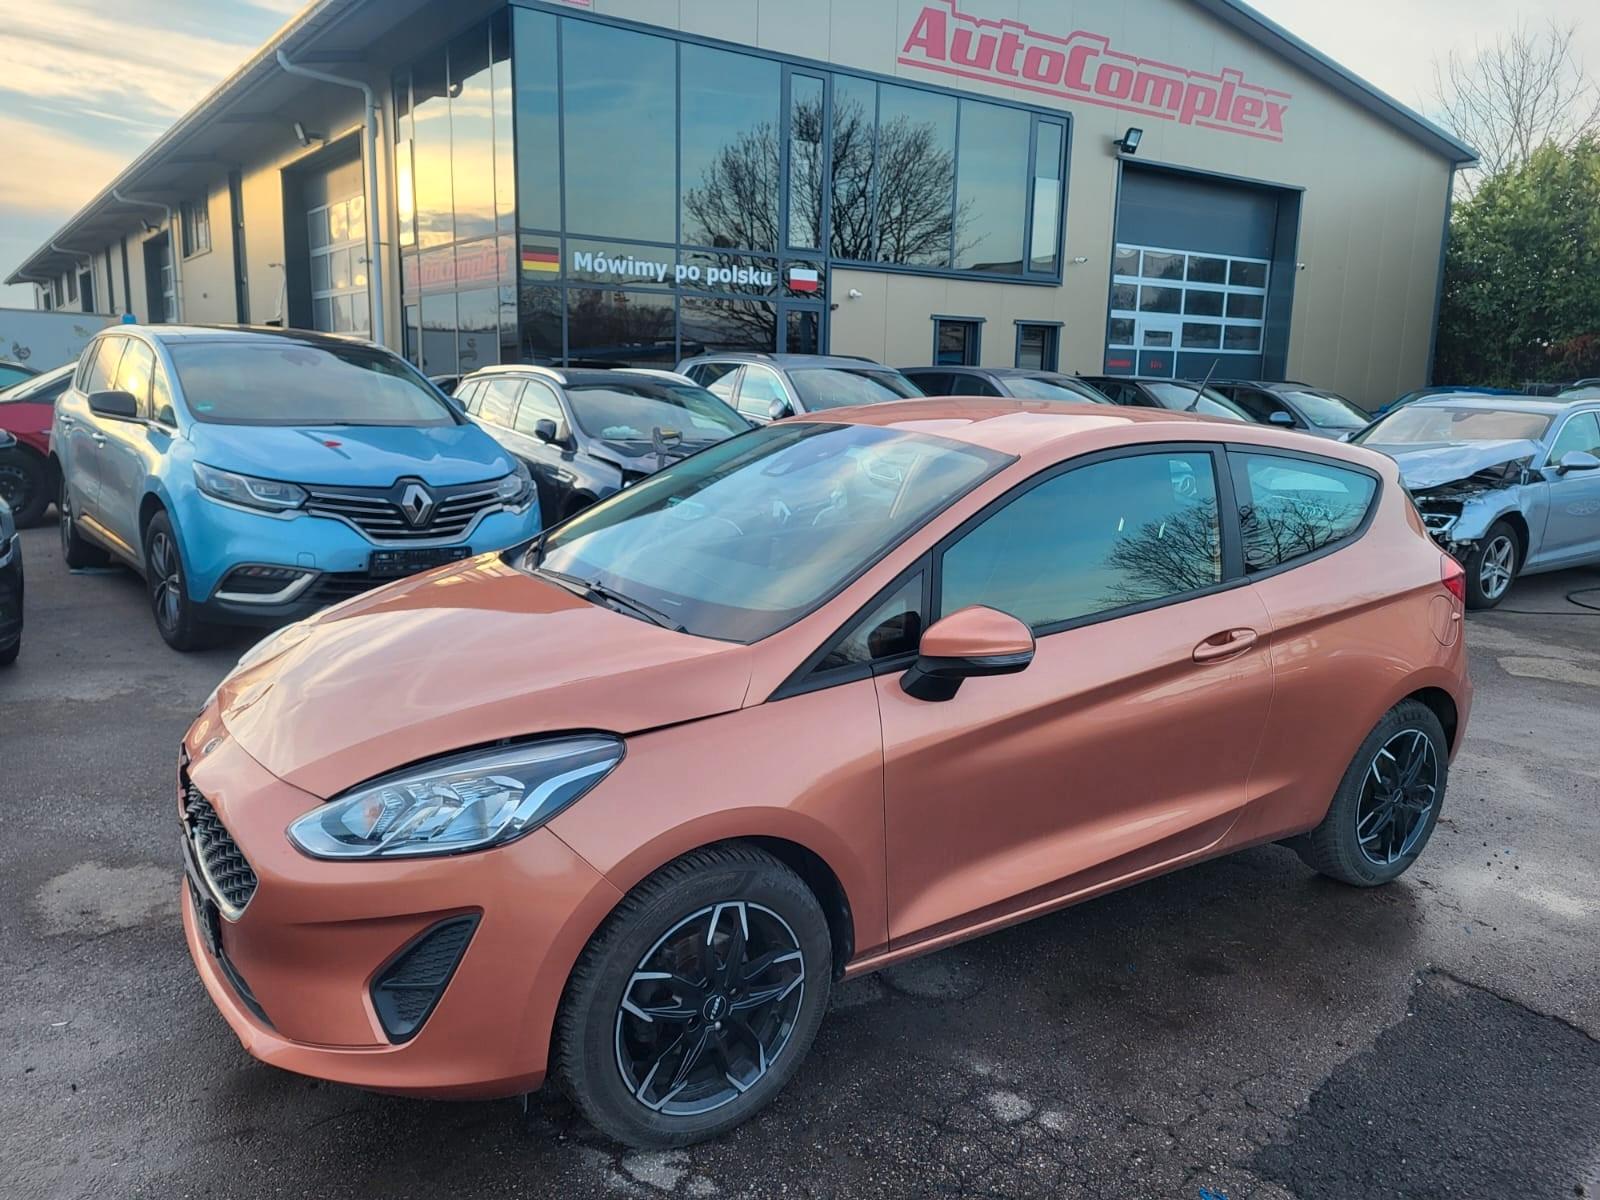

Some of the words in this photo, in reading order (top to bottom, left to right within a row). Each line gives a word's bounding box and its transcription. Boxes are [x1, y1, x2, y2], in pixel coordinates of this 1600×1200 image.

[902, 6, 1288, 132] AutoComplex
[573, 251, 667, 282] Mówimy
[675, 265, 699, 281] po
[706, 265, 772, 287] polsku
